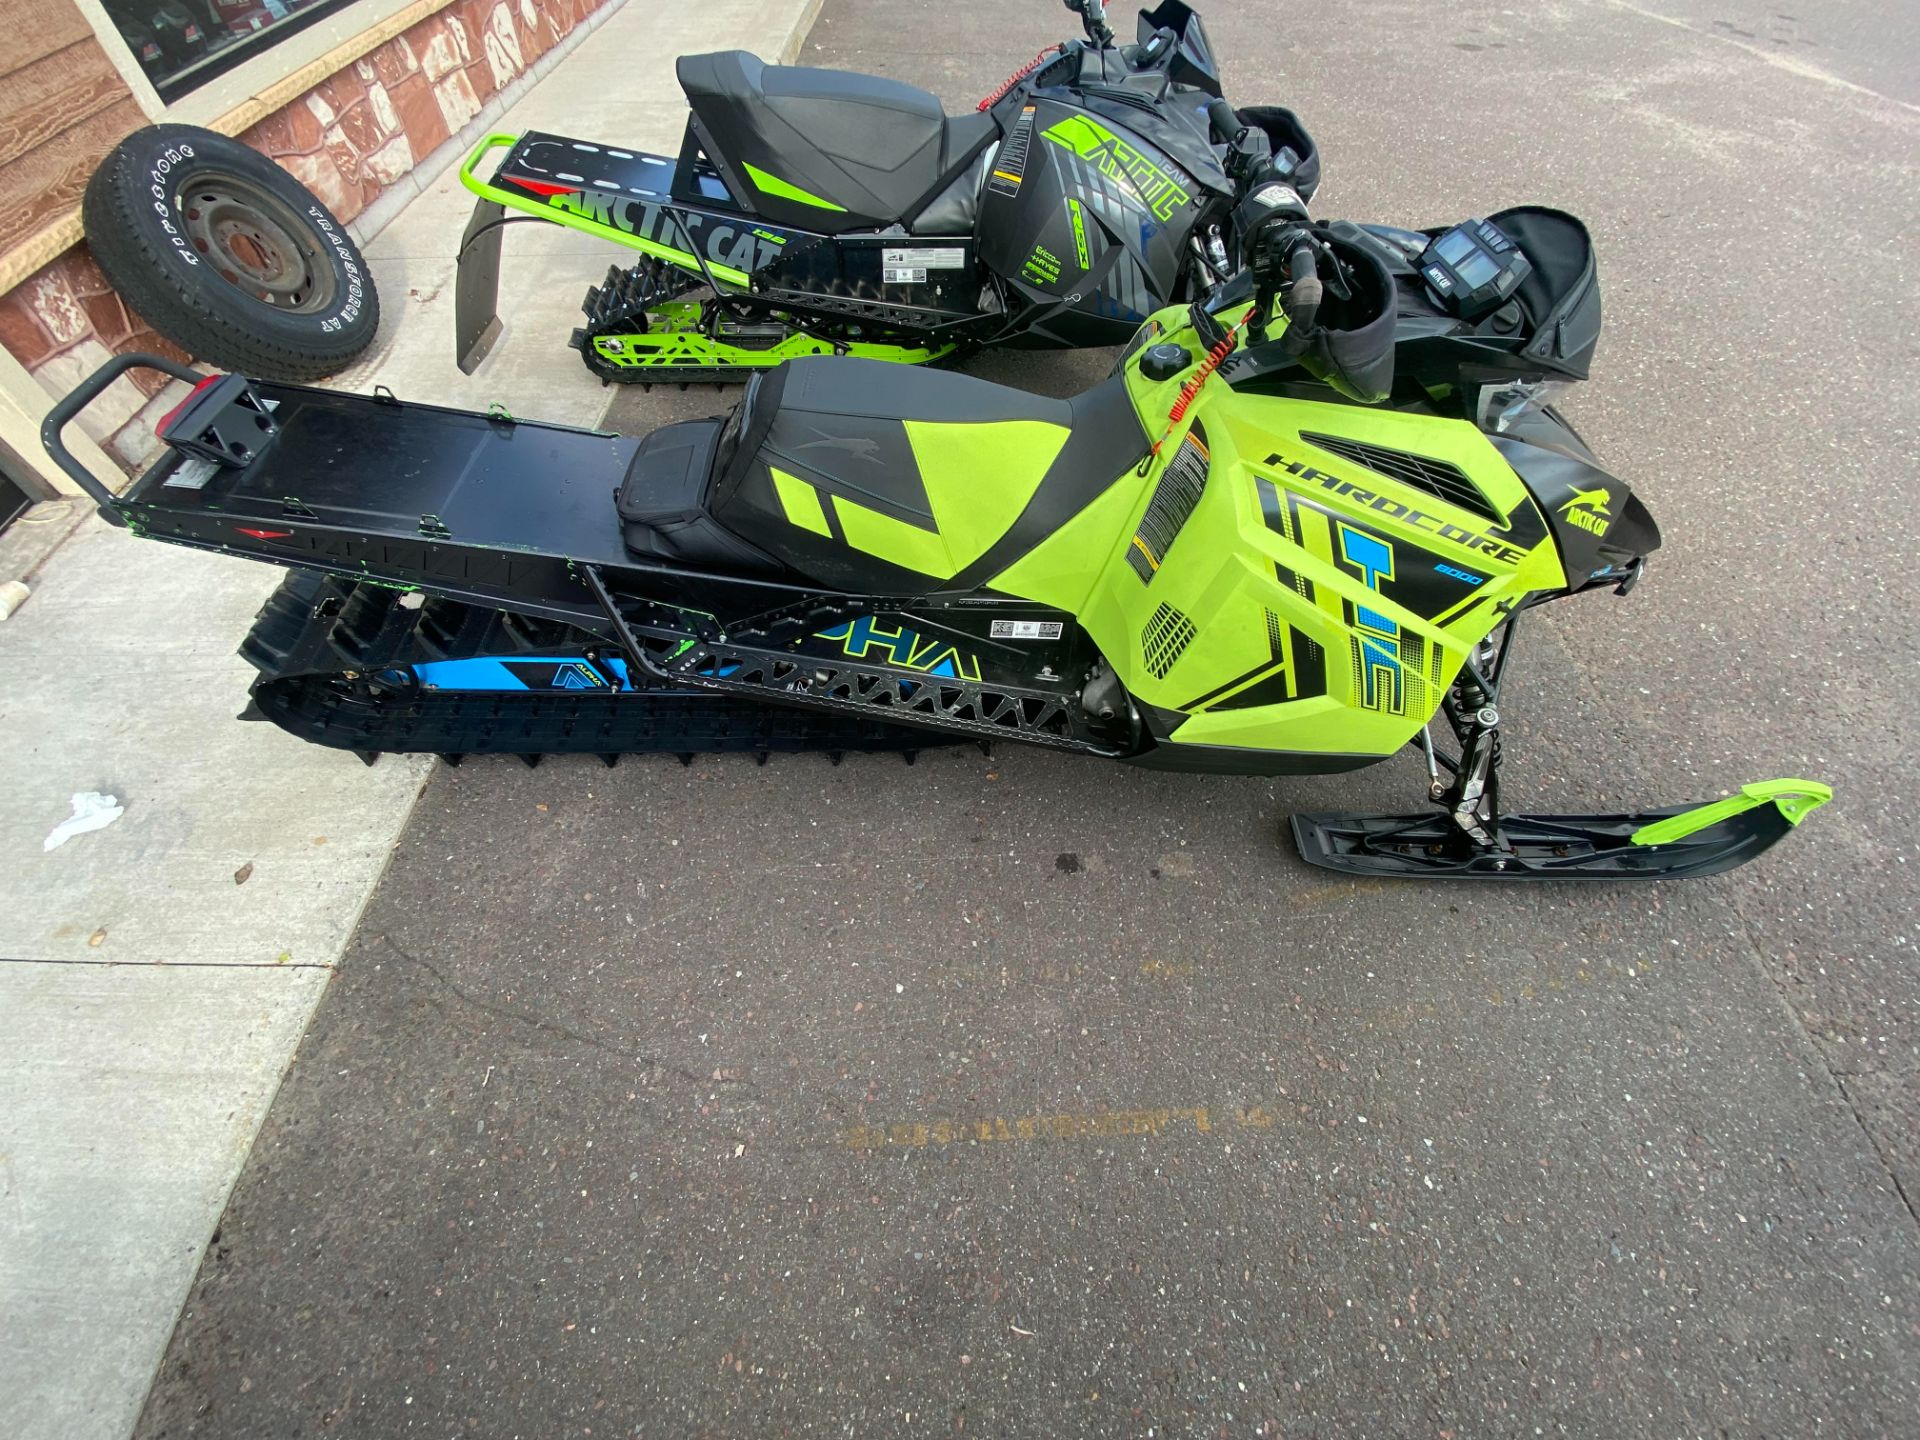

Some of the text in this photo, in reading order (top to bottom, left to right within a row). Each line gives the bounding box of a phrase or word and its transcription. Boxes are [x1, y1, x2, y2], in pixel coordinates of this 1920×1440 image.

[1083, 137, 1190, 222] ARCTIC
[1157, 156, 1191, 188] TEAM
[308, 206, 362, 333] TRANSFORCE AT
[706, 224, 783, 274] CAT
[1263, 452, 1528, 566] HARDCORE
[1566, 506, 1610, 537] ARCTIC CAT
[1433, 563, 1484, 585] 8000
